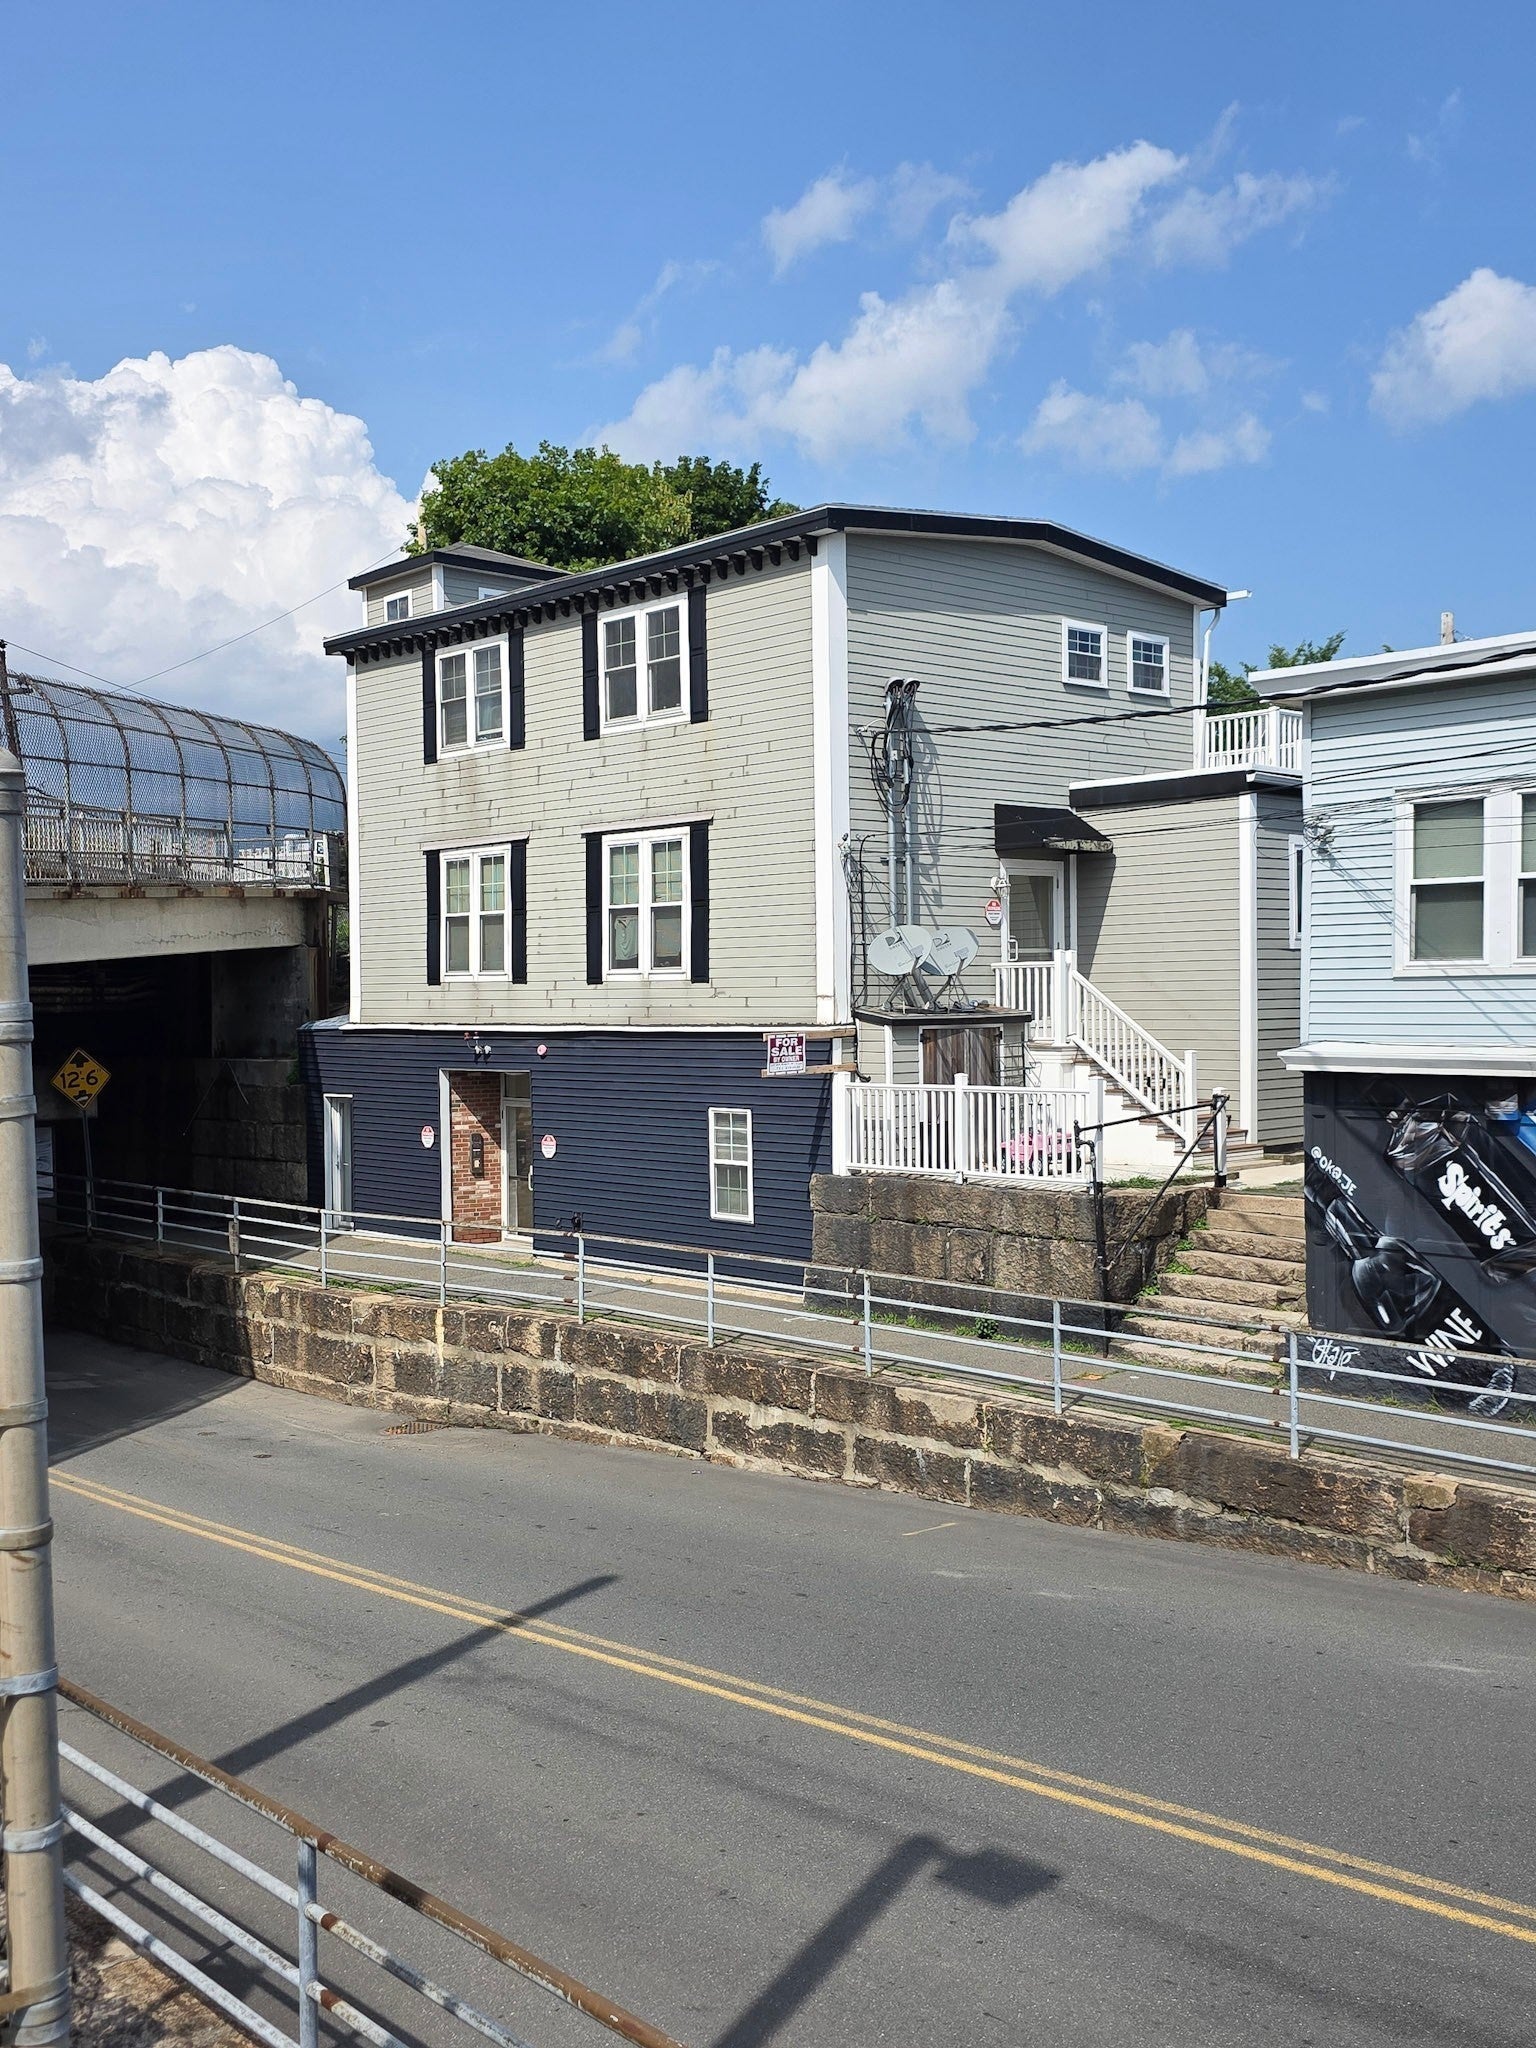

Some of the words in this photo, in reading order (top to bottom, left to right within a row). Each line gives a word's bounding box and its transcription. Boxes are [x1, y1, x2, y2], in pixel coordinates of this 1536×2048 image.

[771, 1046, 803, 1057] SALE
[775, 1037, 799, 1047] FOR
[1437, 1160, 1517, 1250] Spirits
[1406, 1307, 1483, 1377] WINE
